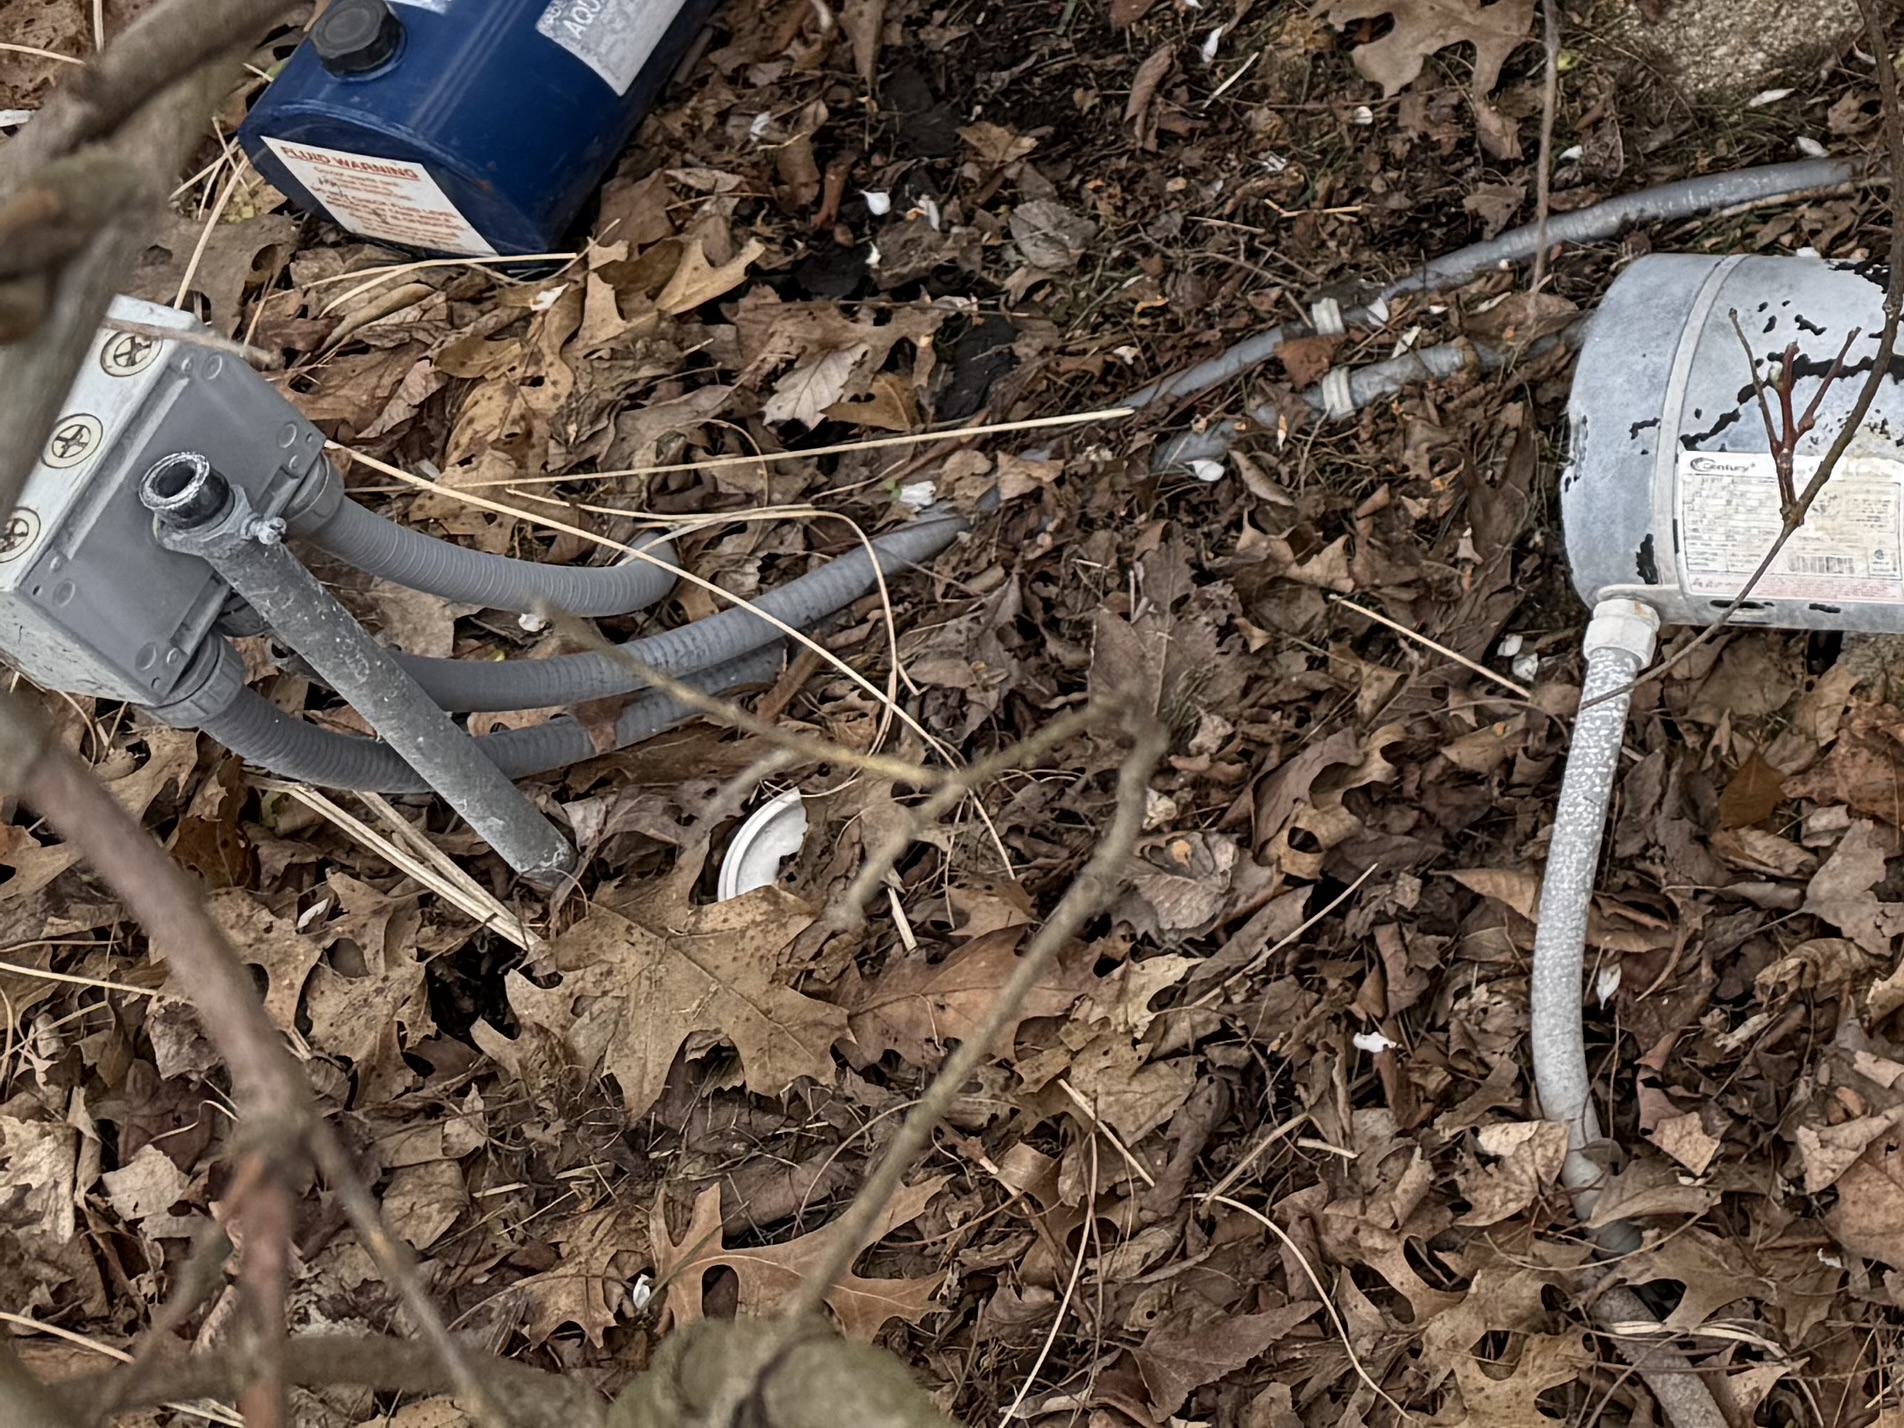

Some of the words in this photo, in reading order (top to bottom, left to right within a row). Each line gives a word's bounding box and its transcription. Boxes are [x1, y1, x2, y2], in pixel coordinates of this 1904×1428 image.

[280, 146, 331, 166] FLUID
[334, 157, 419, 180] WARNING
[1690, 457, 1751, 473] Century
